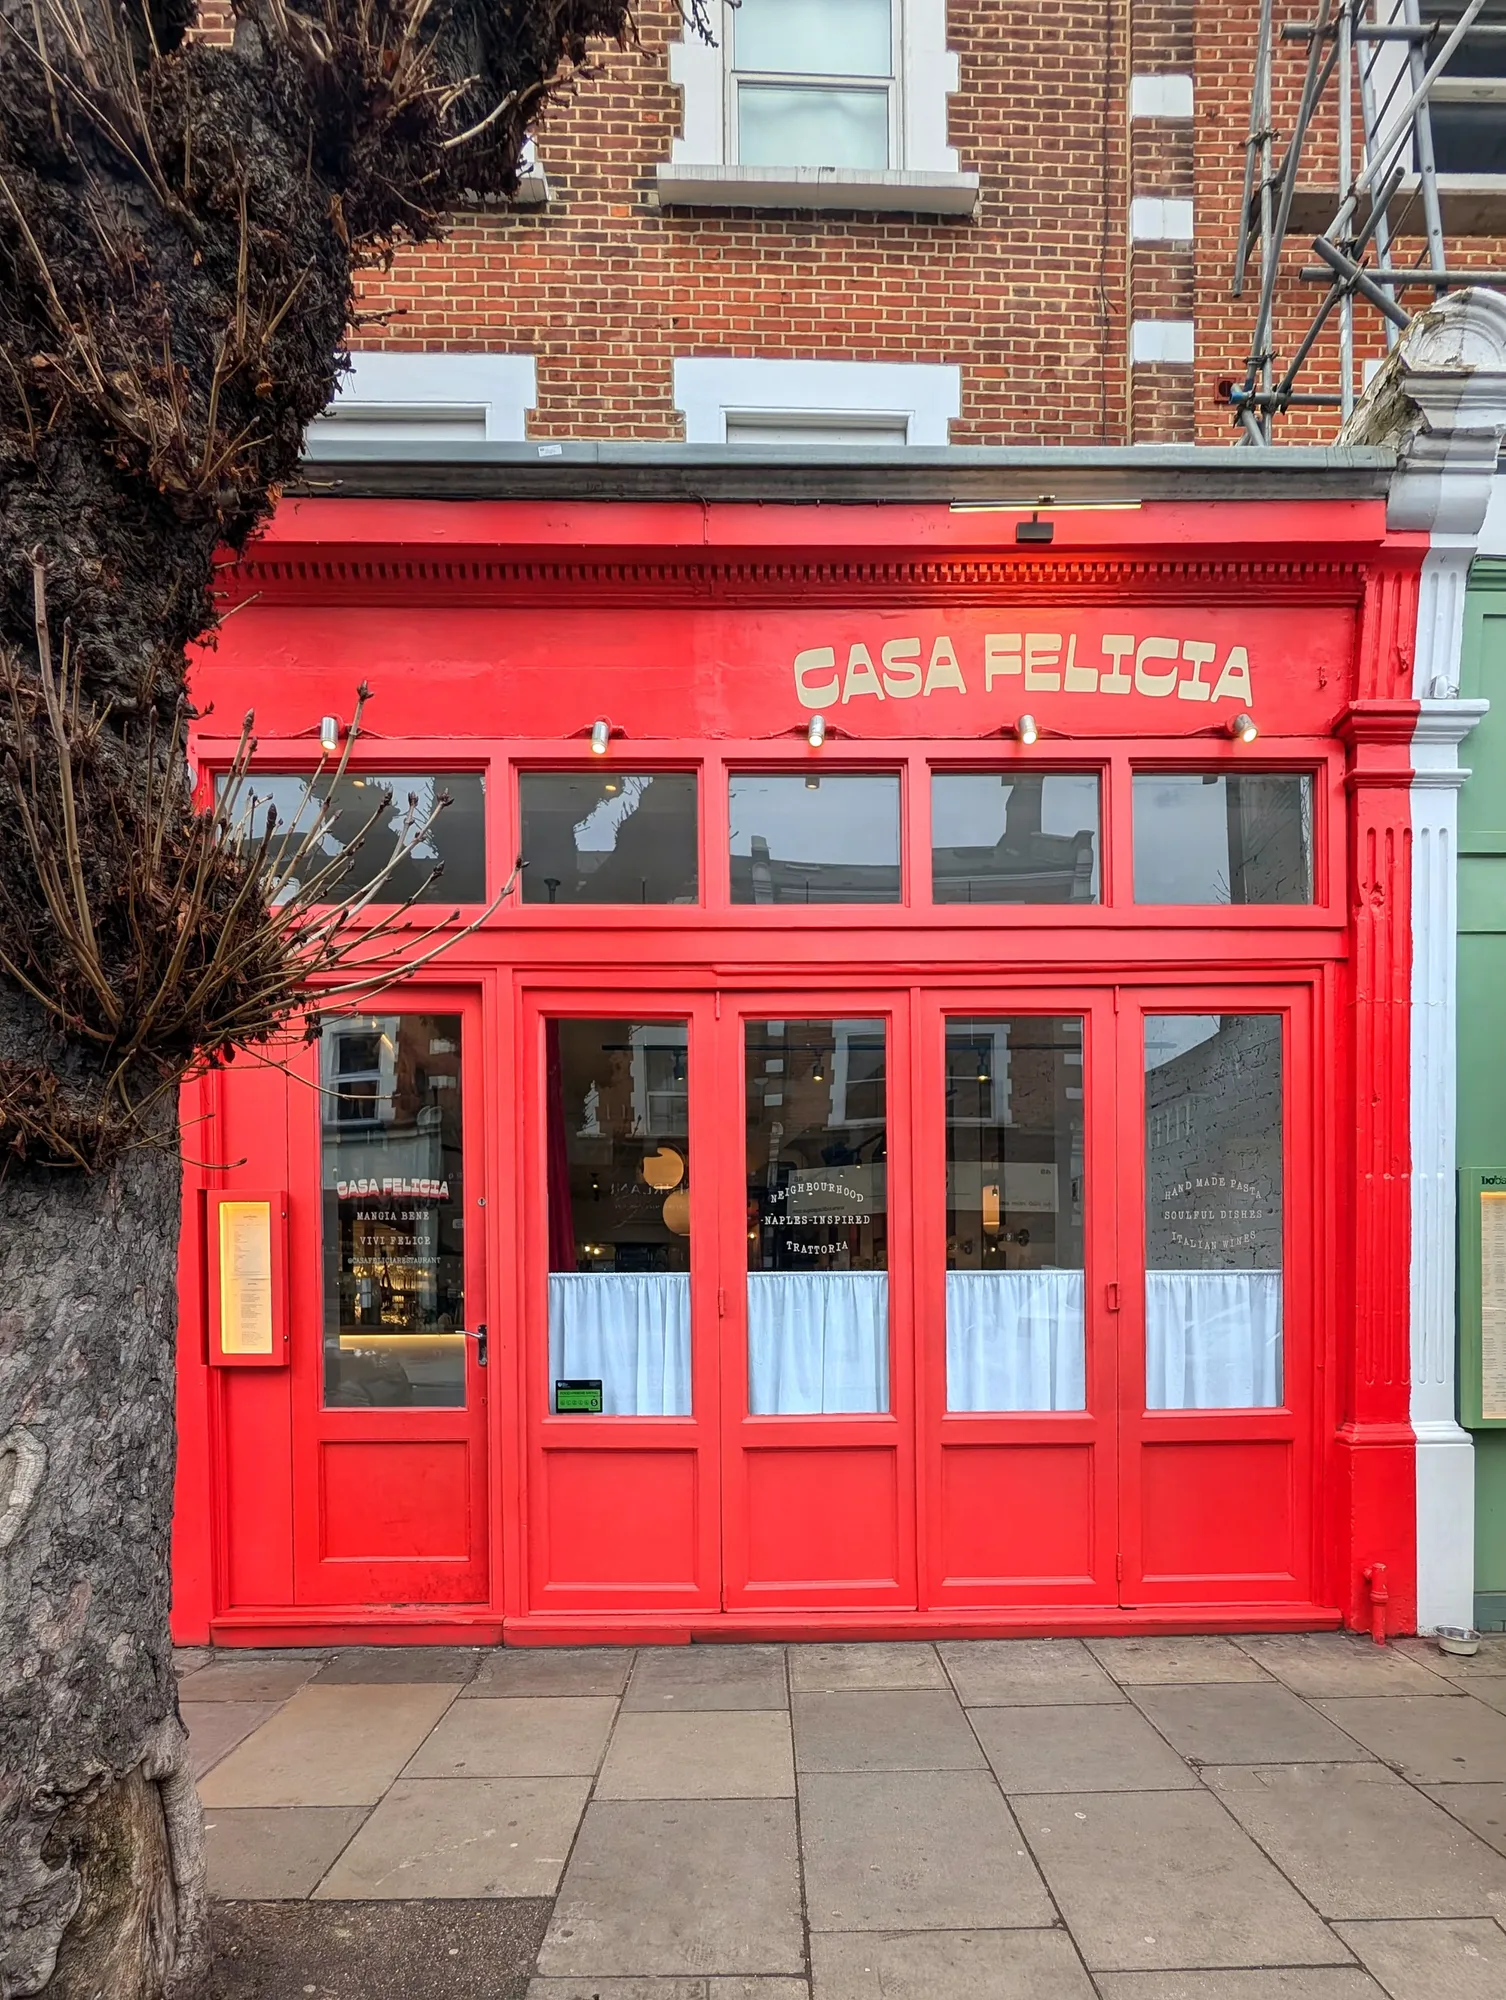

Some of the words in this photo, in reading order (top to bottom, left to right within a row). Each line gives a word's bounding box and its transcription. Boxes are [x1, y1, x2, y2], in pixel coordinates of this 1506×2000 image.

[793, 635, 967, 709] CASA
[984, 632, 1254, 707] FELICIA
[336, 1178, 380, 1199] CASA
[382, 1177, 450, 1199] FELICIA
[770, 1182, 864, 1203] NEIGHBOURHOOD
[1165, 1181, 1192, 1200] HAND
[1196, 1177, 1226, 1187] MADE
[1230, 1179, 1262, 1199] PASTA
[356, 1211, 398, 1220] MANGIA
[400, 1211, 430, 1220] BENE
[1164, 1210, 1215, 1220] SOULFUL
[1220, 1209, 1262, 1219] DISHES
[359, 1236, 386, 1245] VIVI
[389, 1236, 431, 1245] FELICE
[786, 1240, 849, 1255] TRATTORIA
[1171, 1231, 1217, 1250] ITALIAN
[1222, 1230, 1256, 1249] WINES
